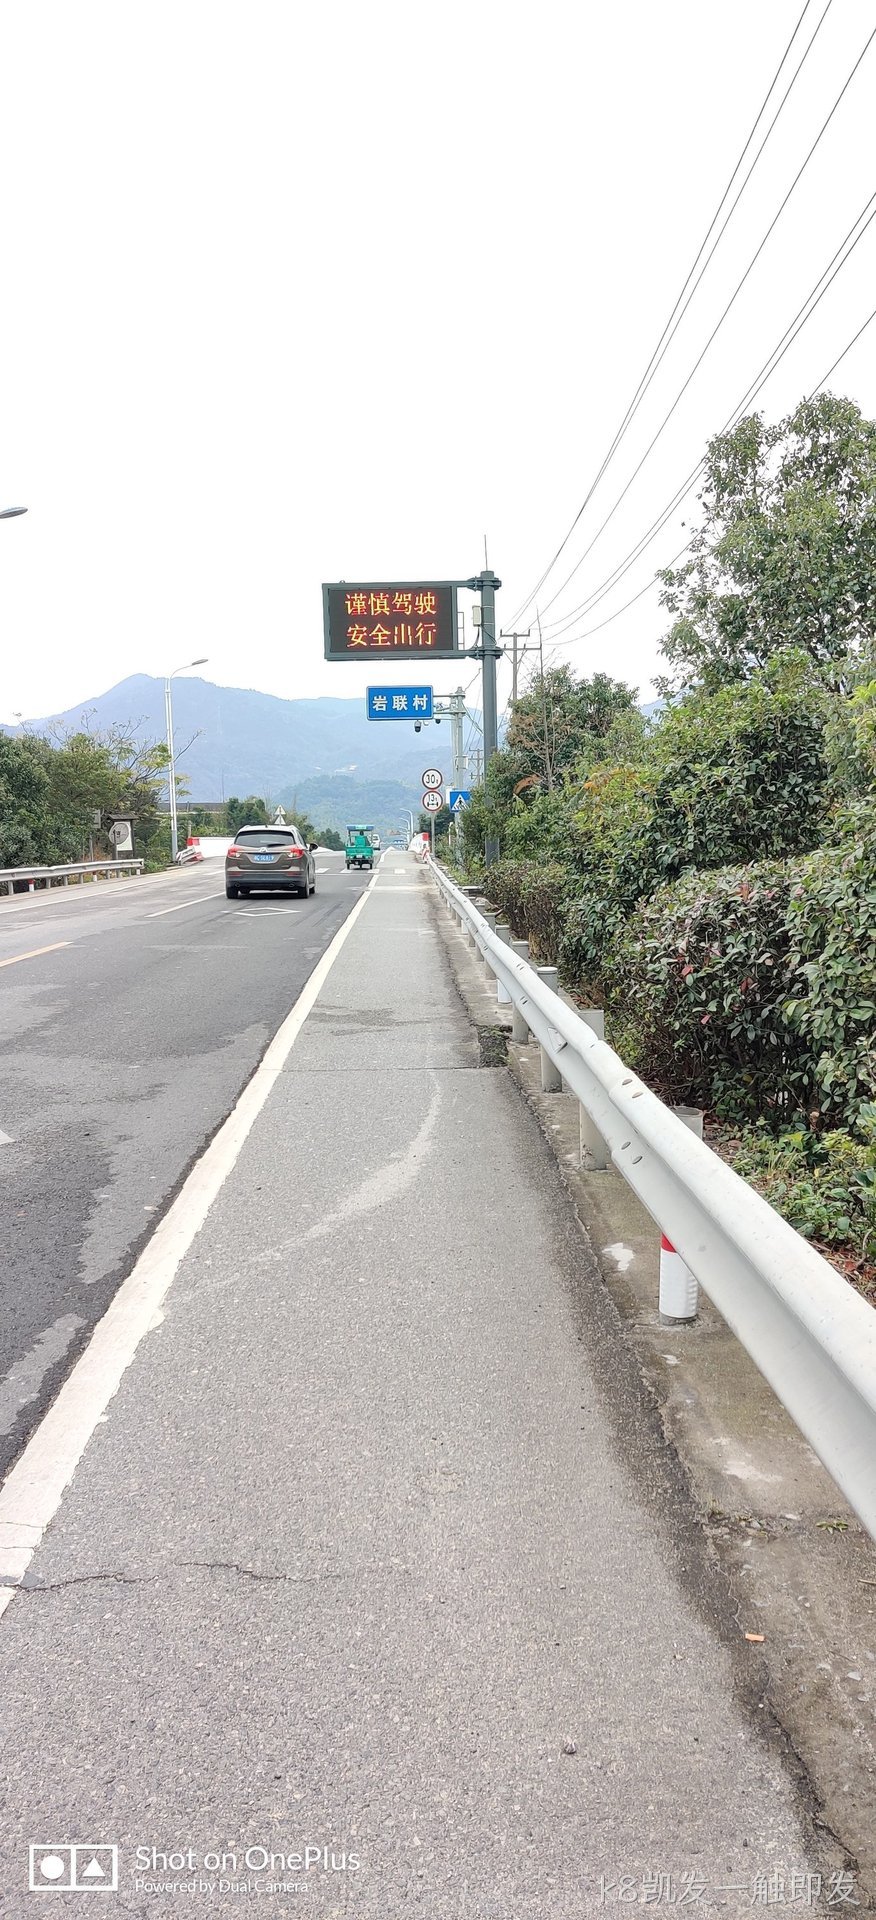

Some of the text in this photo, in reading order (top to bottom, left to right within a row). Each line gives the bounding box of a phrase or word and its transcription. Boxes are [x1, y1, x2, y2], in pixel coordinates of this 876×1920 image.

[345, 591, 437, 616] 谨慎驾驶
[372, 694, 428, 712] 岩联村
